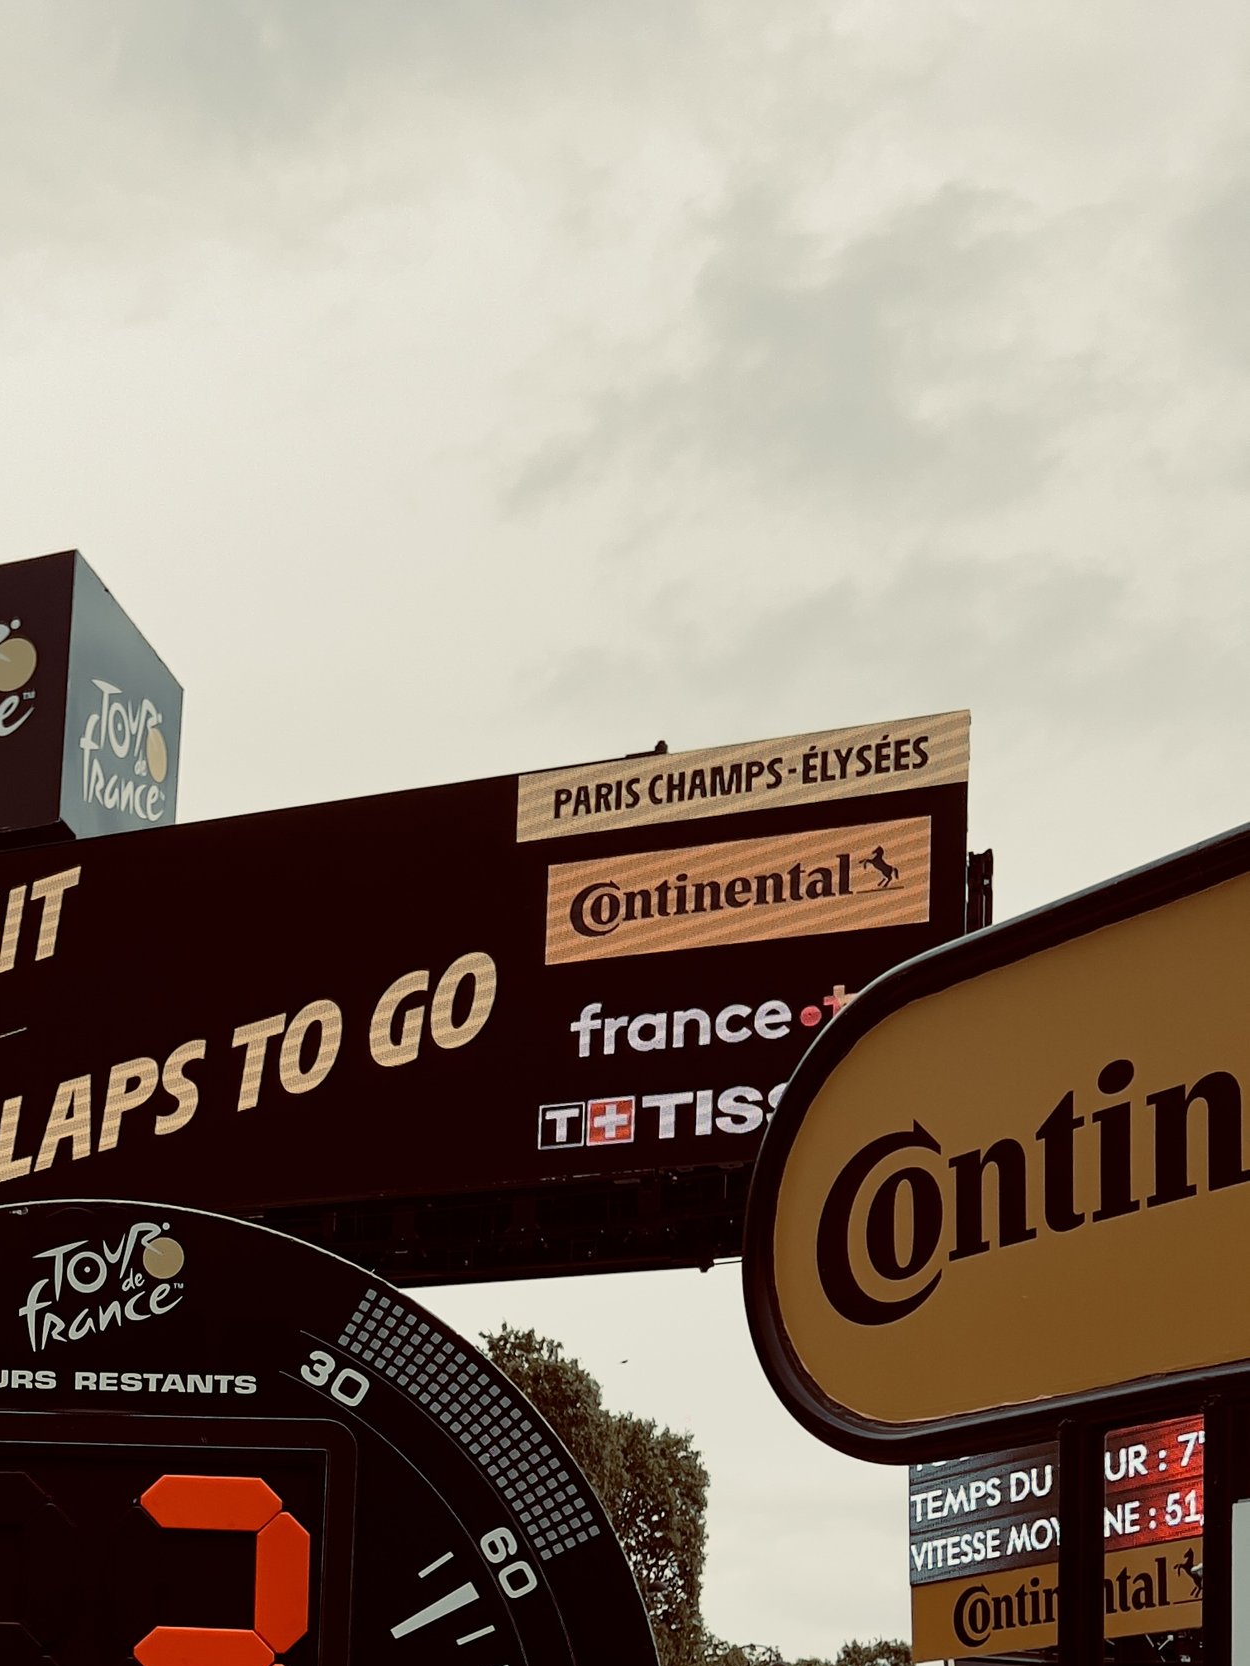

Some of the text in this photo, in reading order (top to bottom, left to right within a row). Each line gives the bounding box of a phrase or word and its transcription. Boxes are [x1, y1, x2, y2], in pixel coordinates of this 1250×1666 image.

[91, 679, 161, 759] TOUR
[80, 714, 164, 821] france
[134, 758, 147, 776] de
[554, 735, 929, 819] PARIS CHAMPS-ÉLYSÉES
[569, 853, 852, 938] Continental
[232, 1000, 342, 1111] TO
[370, 952, 497, 1067] GO
[33, 1222, 170, 1300] TOUR
[122, 1272, 145, 1293] de
[18, 1279, 183, 1352] france
[75, 1371, 257, 1394] RESTANTS
[301, 1350, 369, 1407] 30
[910, 1477, 1001, 1523] TEMPS
[1010, 1464, 1053, 1503] DU
[480, 1527, 537, 1598] 60
[911, 1529, 1001, 1572] VITESSE
